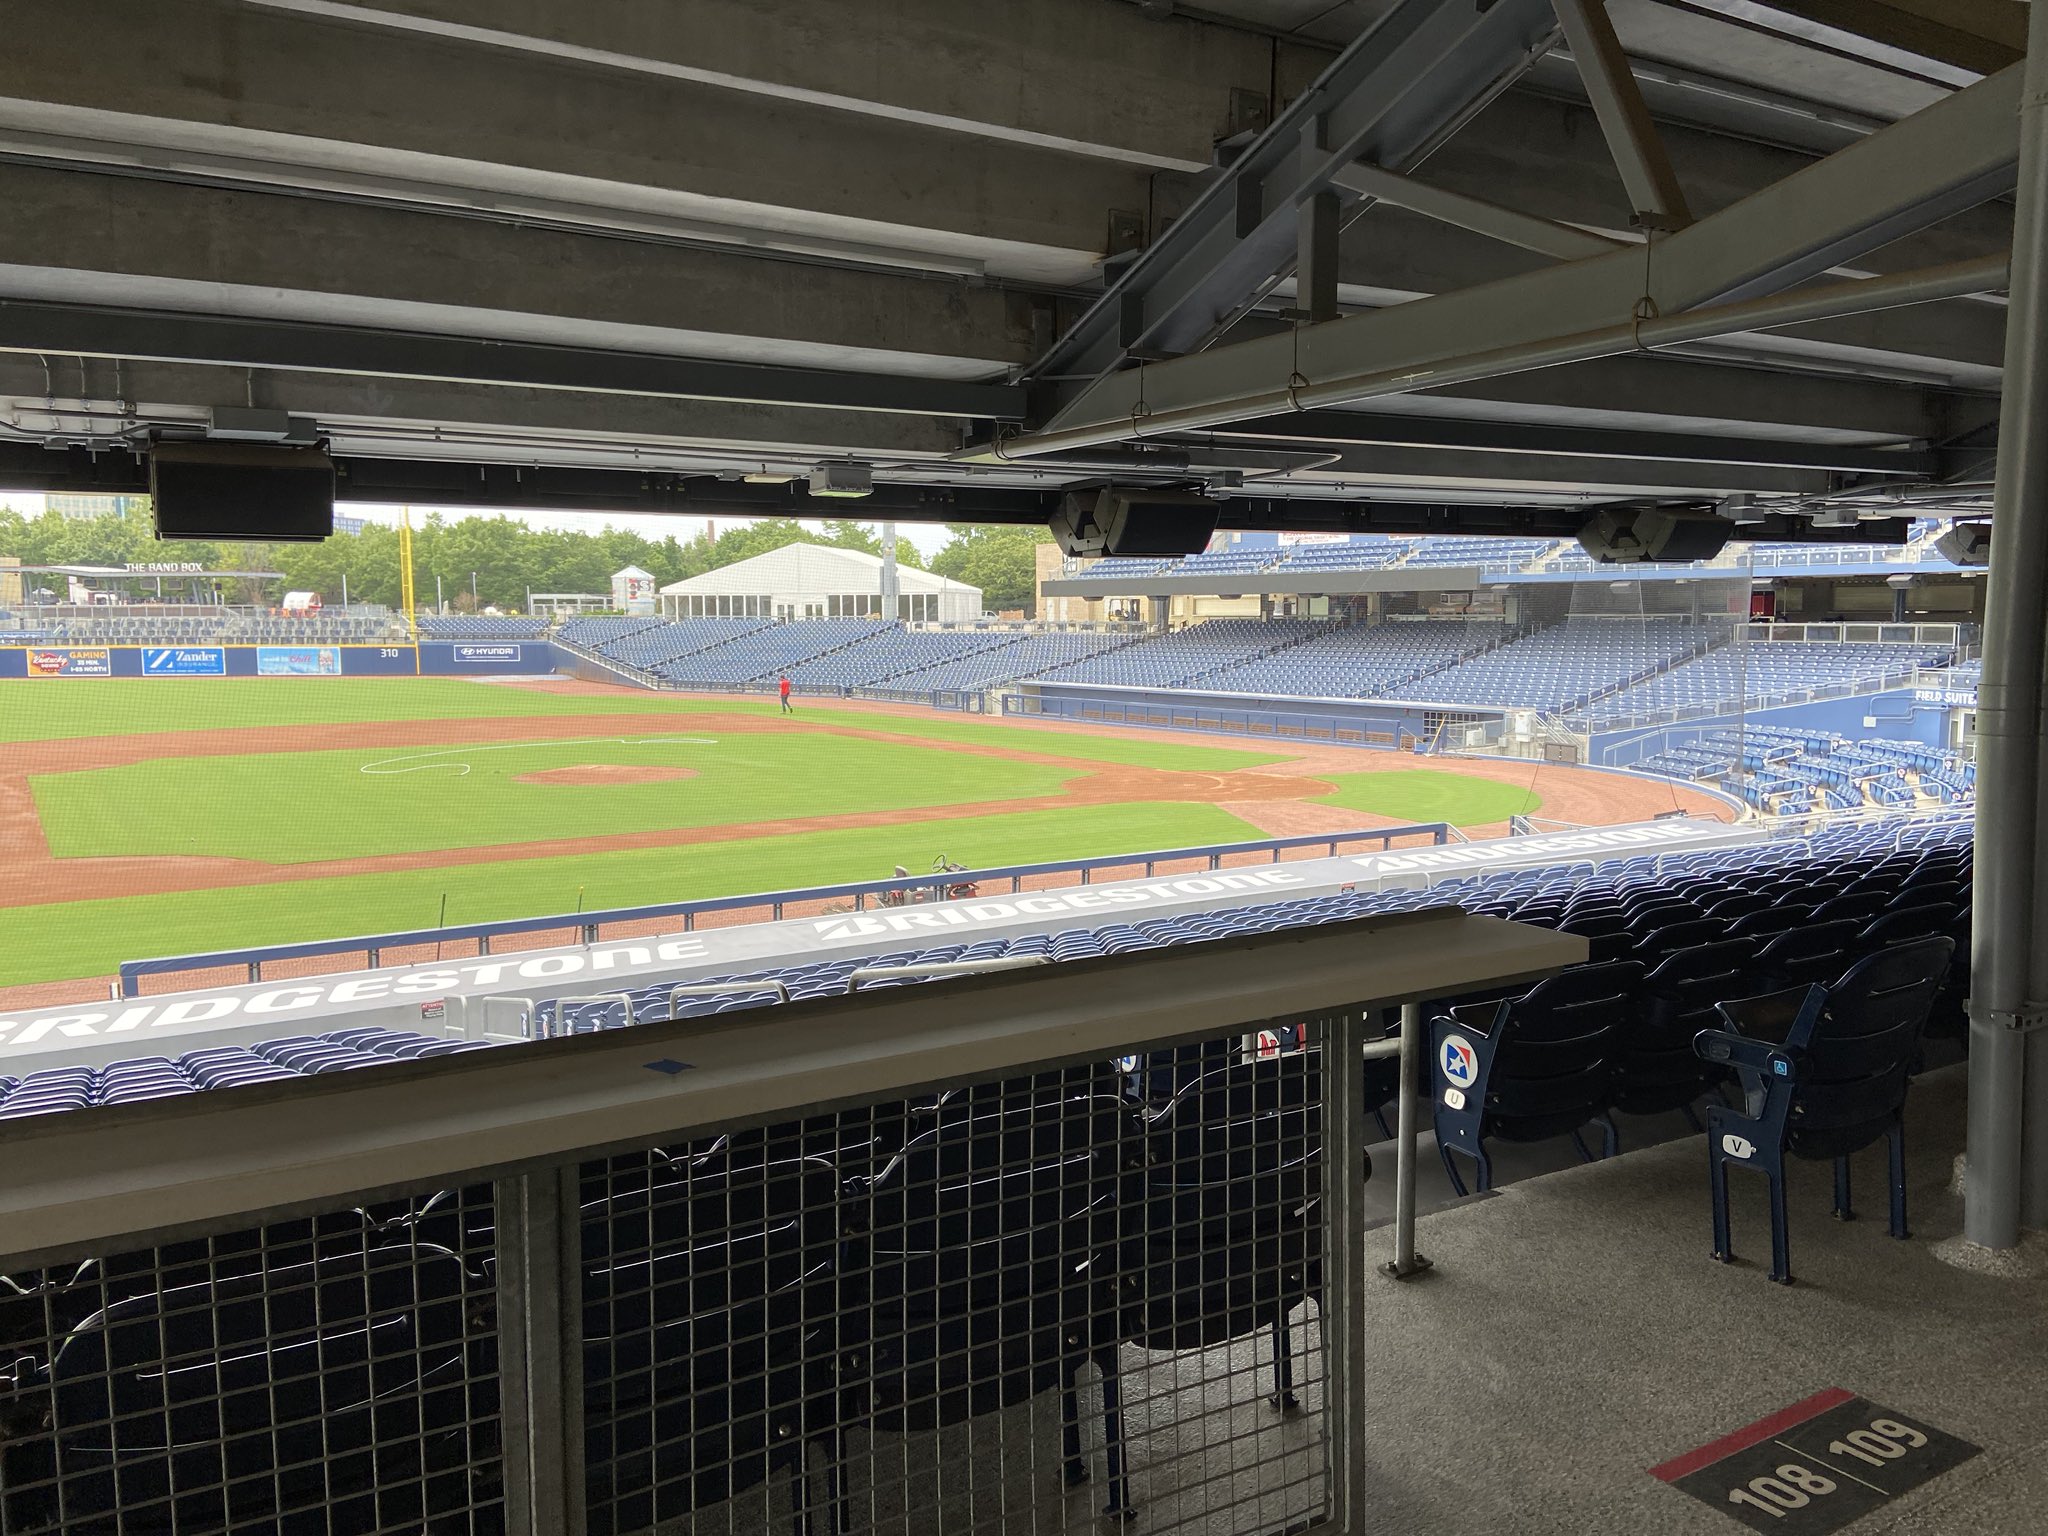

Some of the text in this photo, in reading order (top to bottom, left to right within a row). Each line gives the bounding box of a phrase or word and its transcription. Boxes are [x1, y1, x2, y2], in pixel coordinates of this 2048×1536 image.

[124, 563, 203, 572] THE BAND BOX
[176, 651, 218, 662] Zander
[289, 655, 312, 663] Chill
[380, 648, 399, 658] 310
[32, 654, 68, 666] Kentucky
[1915, 690, 1977, 705] FIELD SUITE
[1351, 823, 1711, 872] BRIDGESTONE
[812, 868, 1299, 940] BRIDGESTONE
[1450, 1092, 1459, 1105] U
[1731, 1139, 1742, 1153] V
[1728, 1418, 1928, 1518] 108 109
